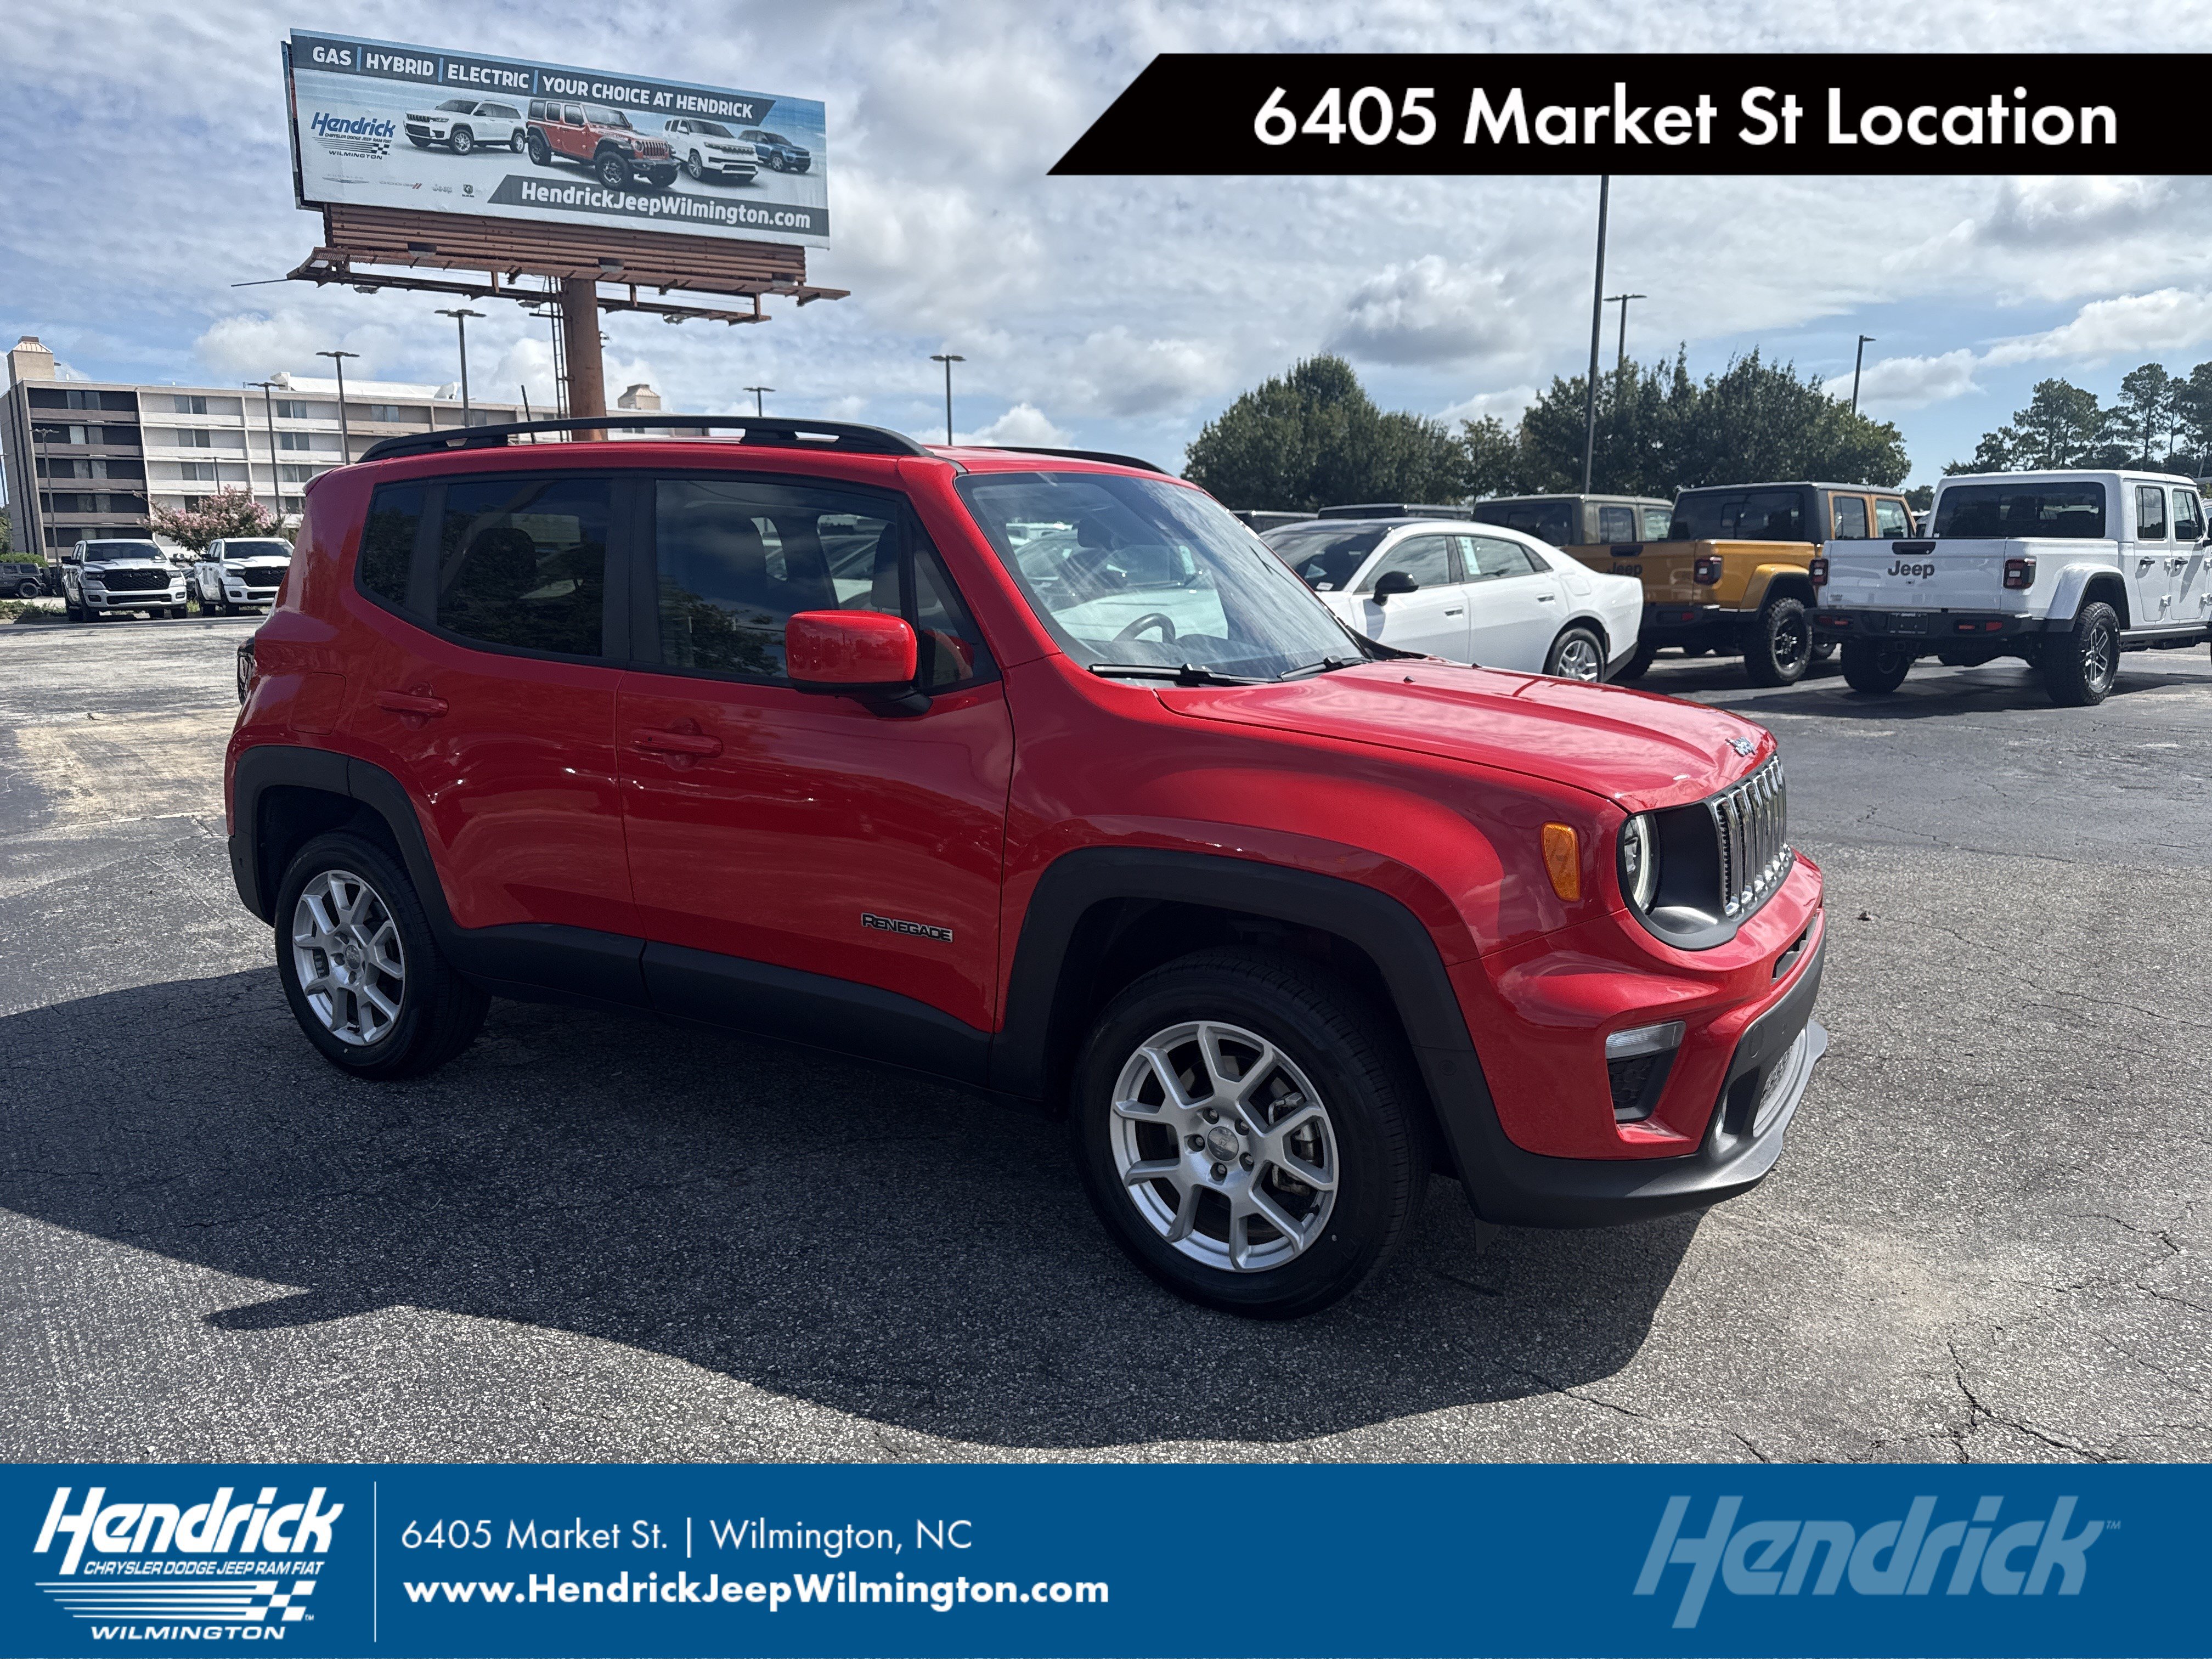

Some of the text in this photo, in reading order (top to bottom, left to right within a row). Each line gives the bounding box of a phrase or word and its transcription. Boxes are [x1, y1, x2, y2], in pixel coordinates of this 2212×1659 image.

[312, 46, 753, 119] GAS HYBRID ELECTRIC YOUR CHOICE AT HENDRICK
[311, 112, 396, 138] Hendrick
[329, 150, 382, 160] WILMINGTON
[521, 181, 810, 229] HendrickJeepWilmington.com
[1887, 560, 1935, 579] Jeep
[861, 912, 953, 943] RENEGADE
